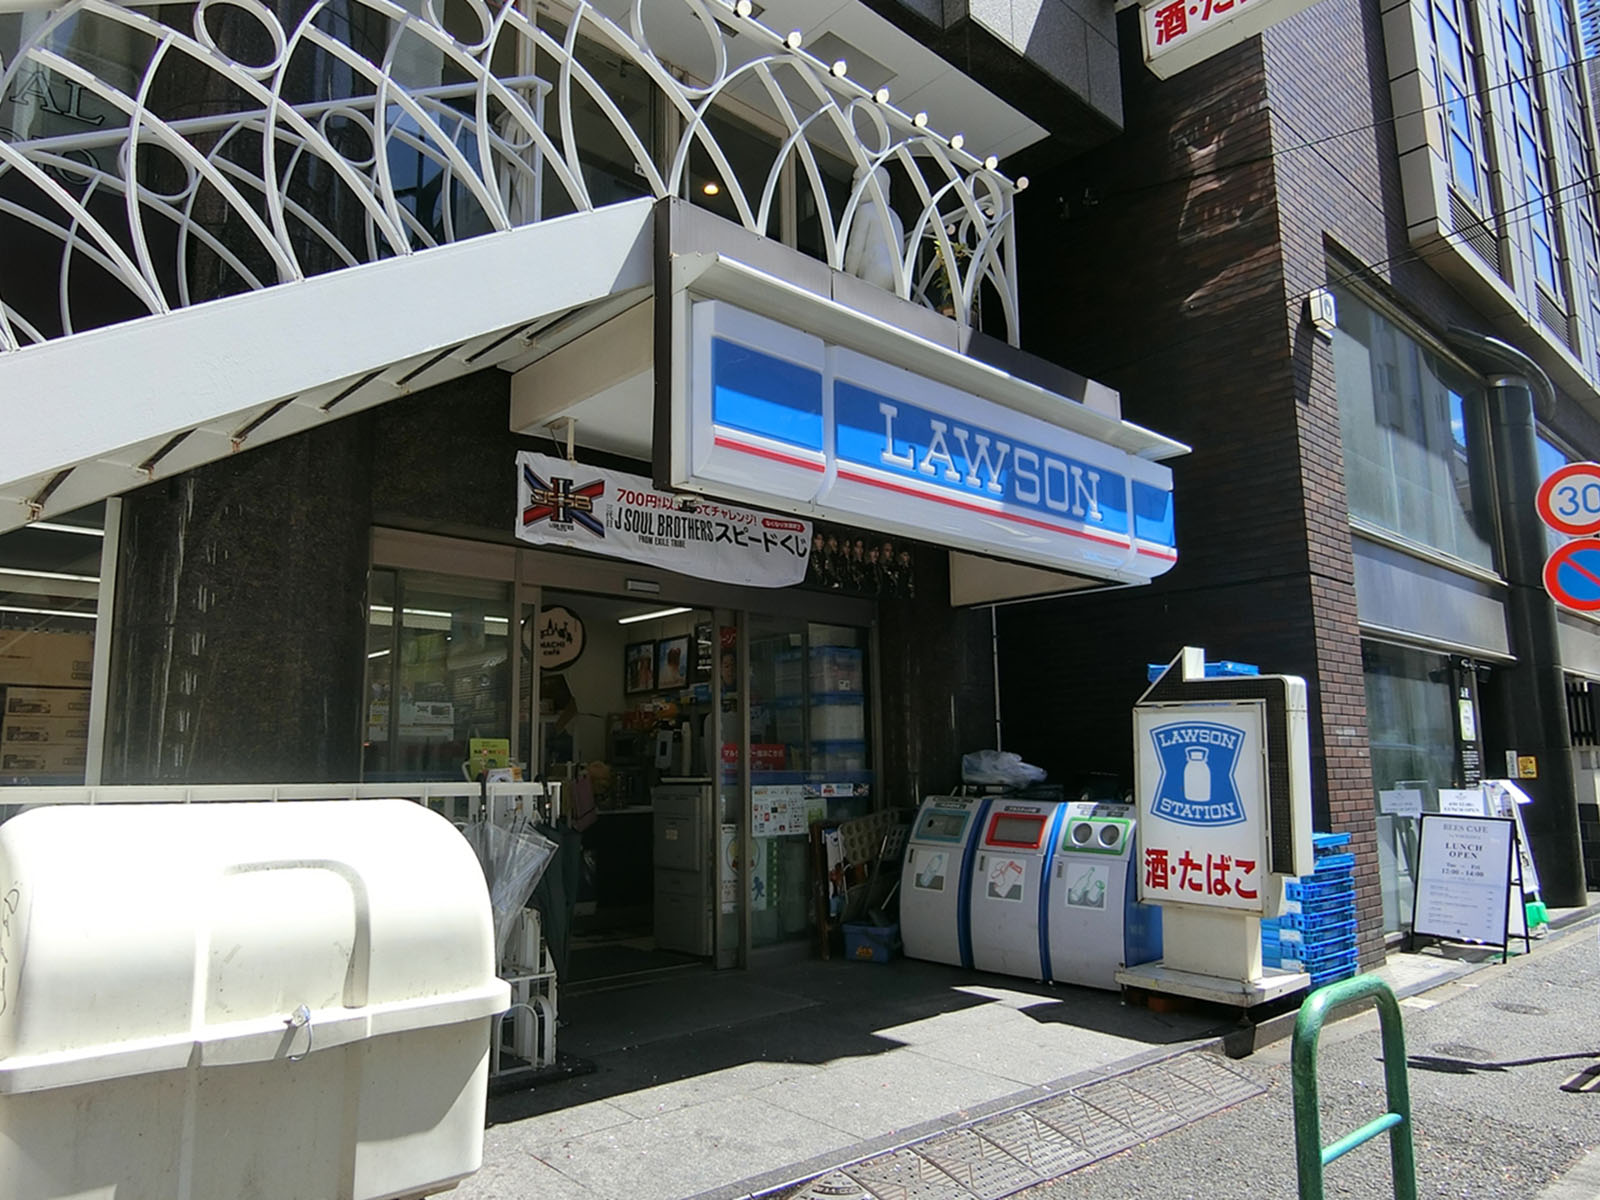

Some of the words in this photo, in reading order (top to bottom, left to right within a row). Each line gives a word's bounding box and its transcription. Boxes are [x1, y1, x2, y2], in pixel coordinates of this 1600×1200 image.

[879, 402, 1103, 522] LAWSON
[1556, 482, 1600, 517] 30
[614, 507, 623, 530] J
[624, 508, 656, 536] SOUL
[657, 513, 713, 543] BROTHERS
[714, 522, 808, 558] スピードくじ
[655, 537, 670, 547] EXILE
[1158, 728, 1237, 750] LAWSON
[1159, 797, 1237, 820] STATION
[1445, 842, 1483, 852] LUNCH
[1448, 850, 1478, 859] OPEN
[1145, 847, 1258, 899] 酒・たばこ
